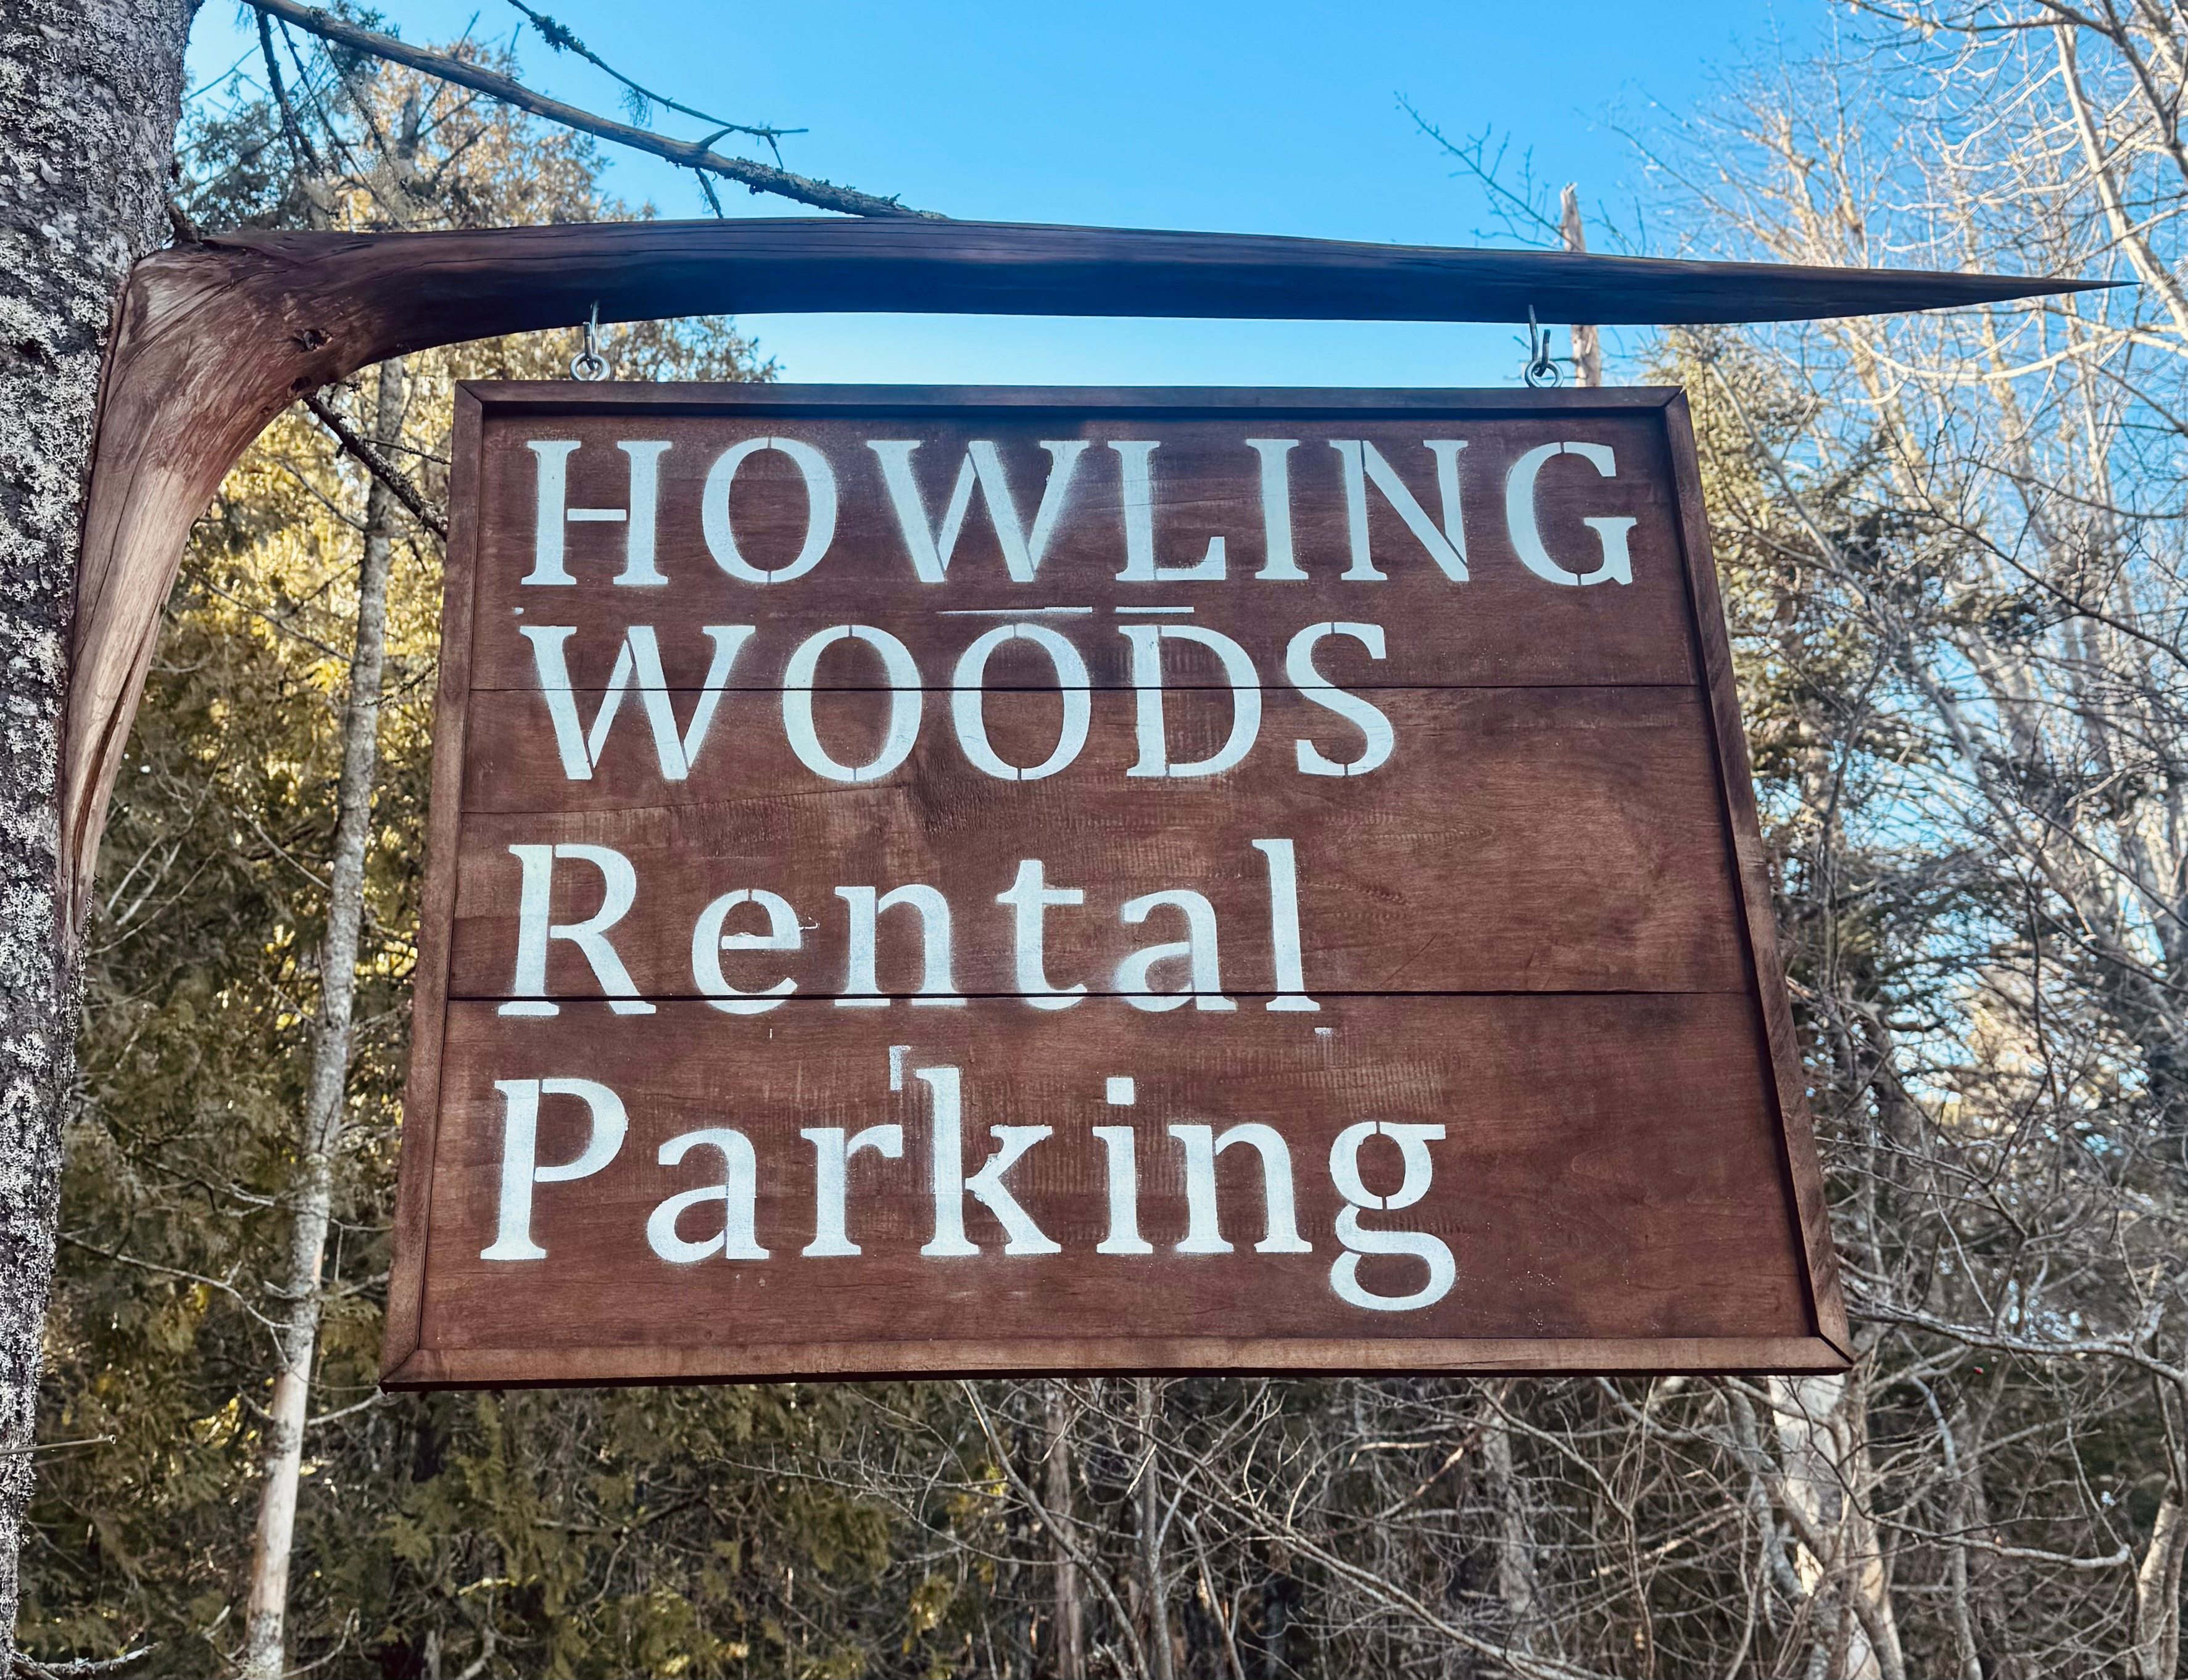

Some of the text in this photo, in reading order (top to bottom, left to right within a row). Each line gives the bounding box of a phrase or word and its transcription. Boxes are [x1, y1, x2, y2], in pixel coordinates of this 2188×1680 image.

[521, 436, 1638, 587] HOWLING
[519, 621, 1397, 785] WOODS
[496, 838, 1322, 1019] Rental
[479, 1063, 1457, 1312] Parking
